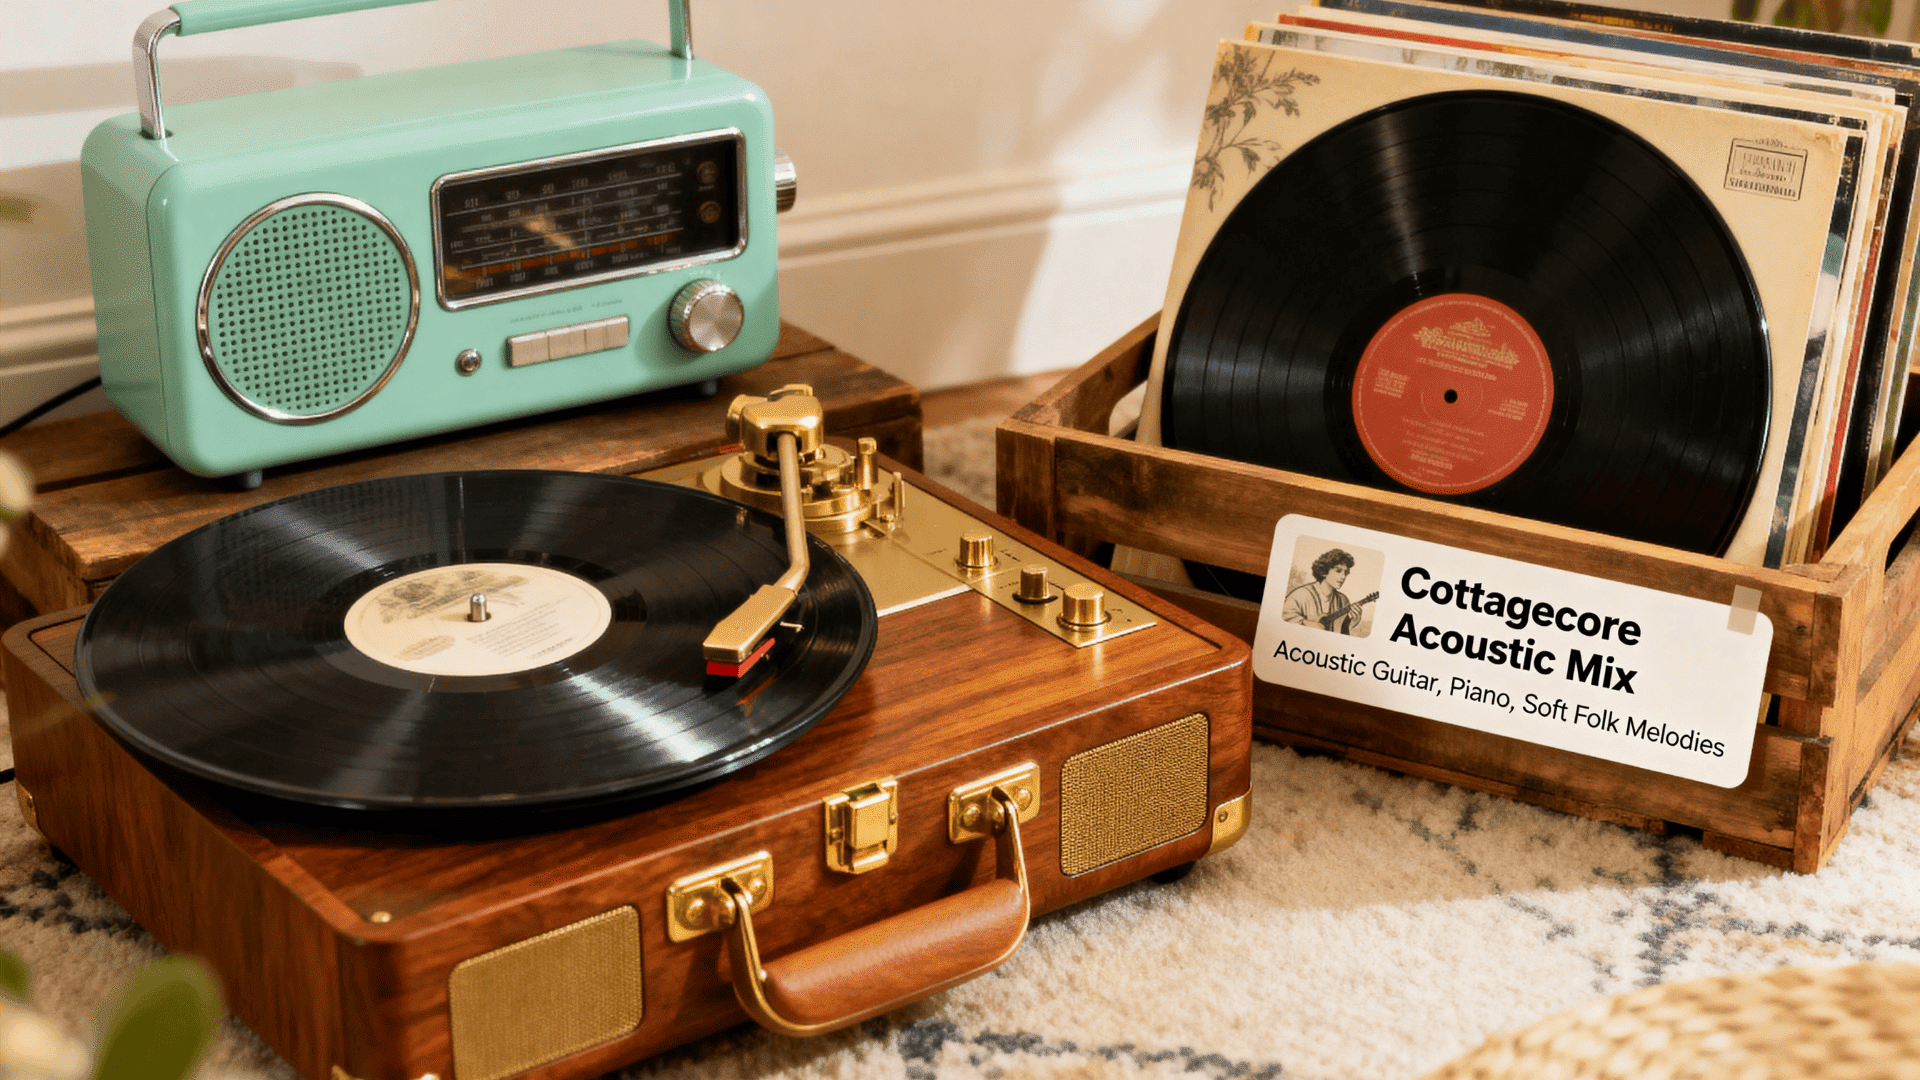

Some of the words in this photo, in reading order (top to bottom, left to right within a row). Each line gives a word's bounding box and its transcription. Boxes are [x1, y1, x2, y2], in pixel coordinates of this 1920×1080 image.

[1401, 566, 1642, 646] Cottagecore
[1389, 612, 1556, 676] Acoustic
[1565, 648, 1638, 695] Mix
[1272, 639, 1367, 677] Acoustic
[1372, 660, 1442, 697] Guitar,
[1449, 676, 1515, 714] Piano,
[1522, 693, 1569, 722] Soft
[1573, 704, 1620, 734] Folk
[1625, 716, 1725, 758] Melodies
